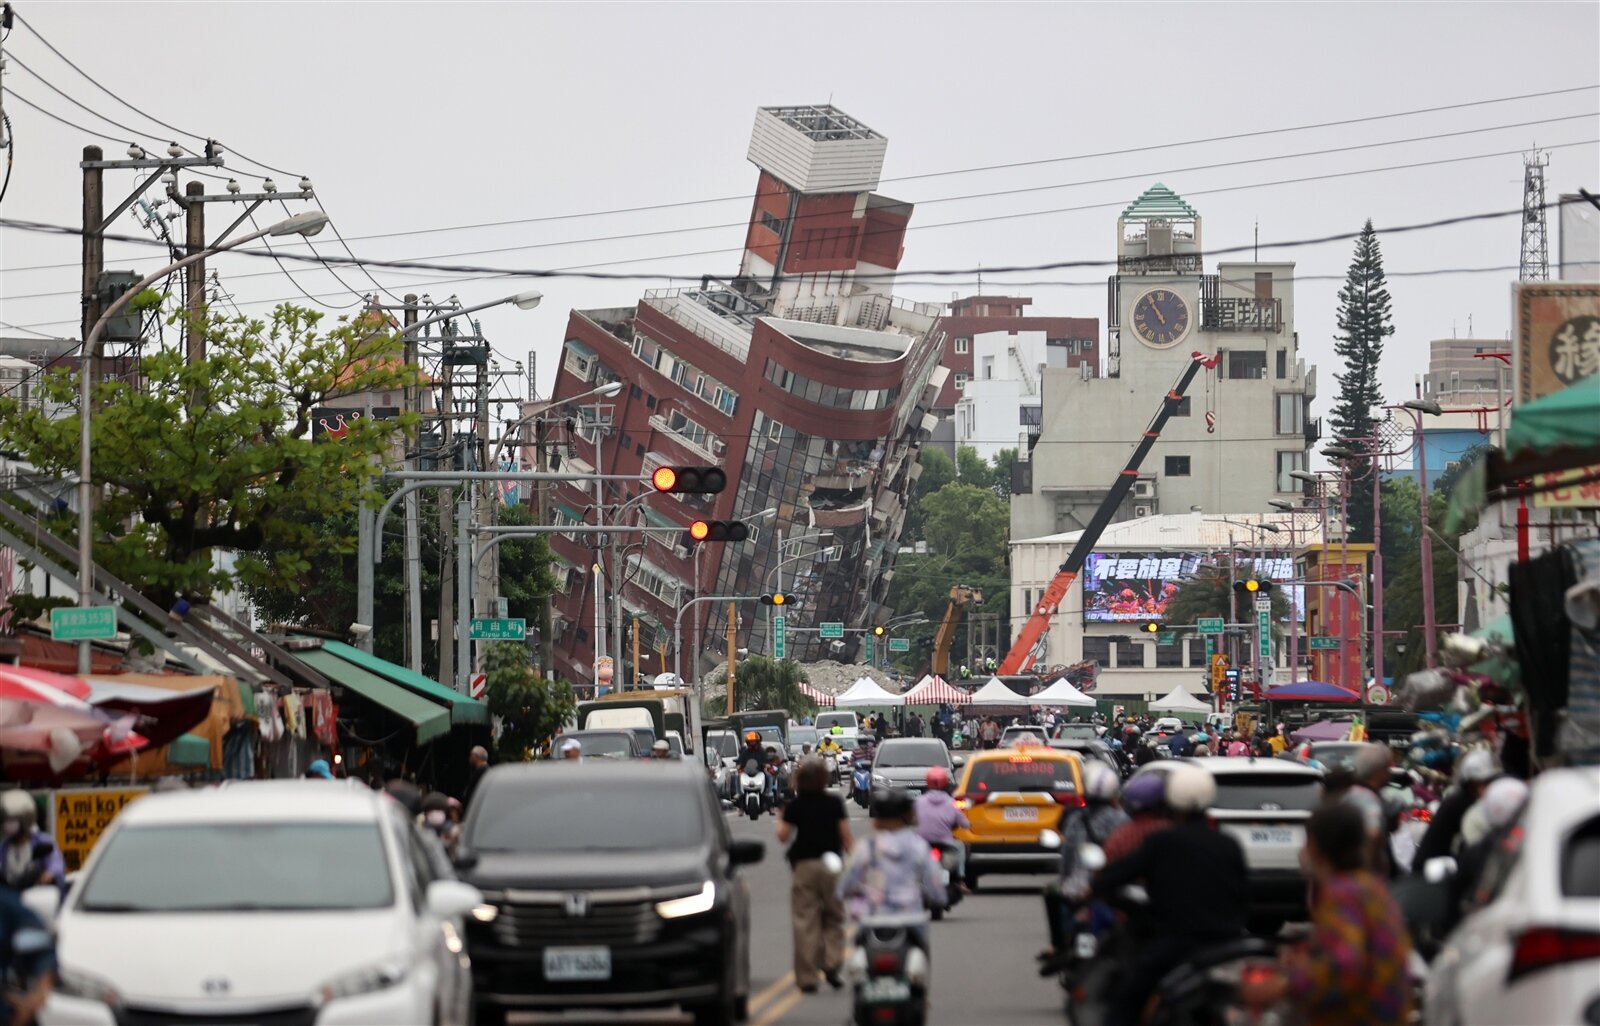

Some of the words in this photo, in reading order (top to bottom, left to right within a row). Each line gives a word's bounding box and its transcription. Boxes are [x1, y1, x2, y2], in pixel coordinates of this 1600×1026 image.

[1094, 558, 1183, 580] 不要放棄
[475, 621, 518, 631] 自由街
[480, 630, 500, 638] Ziyou
[59, 796, 70, 814] A
[74, 796, 92, 814] mi
[96, 796, 115, 813] ko
[65, 819, 88, 830] AM
[65, 833, 87, 844] PM
